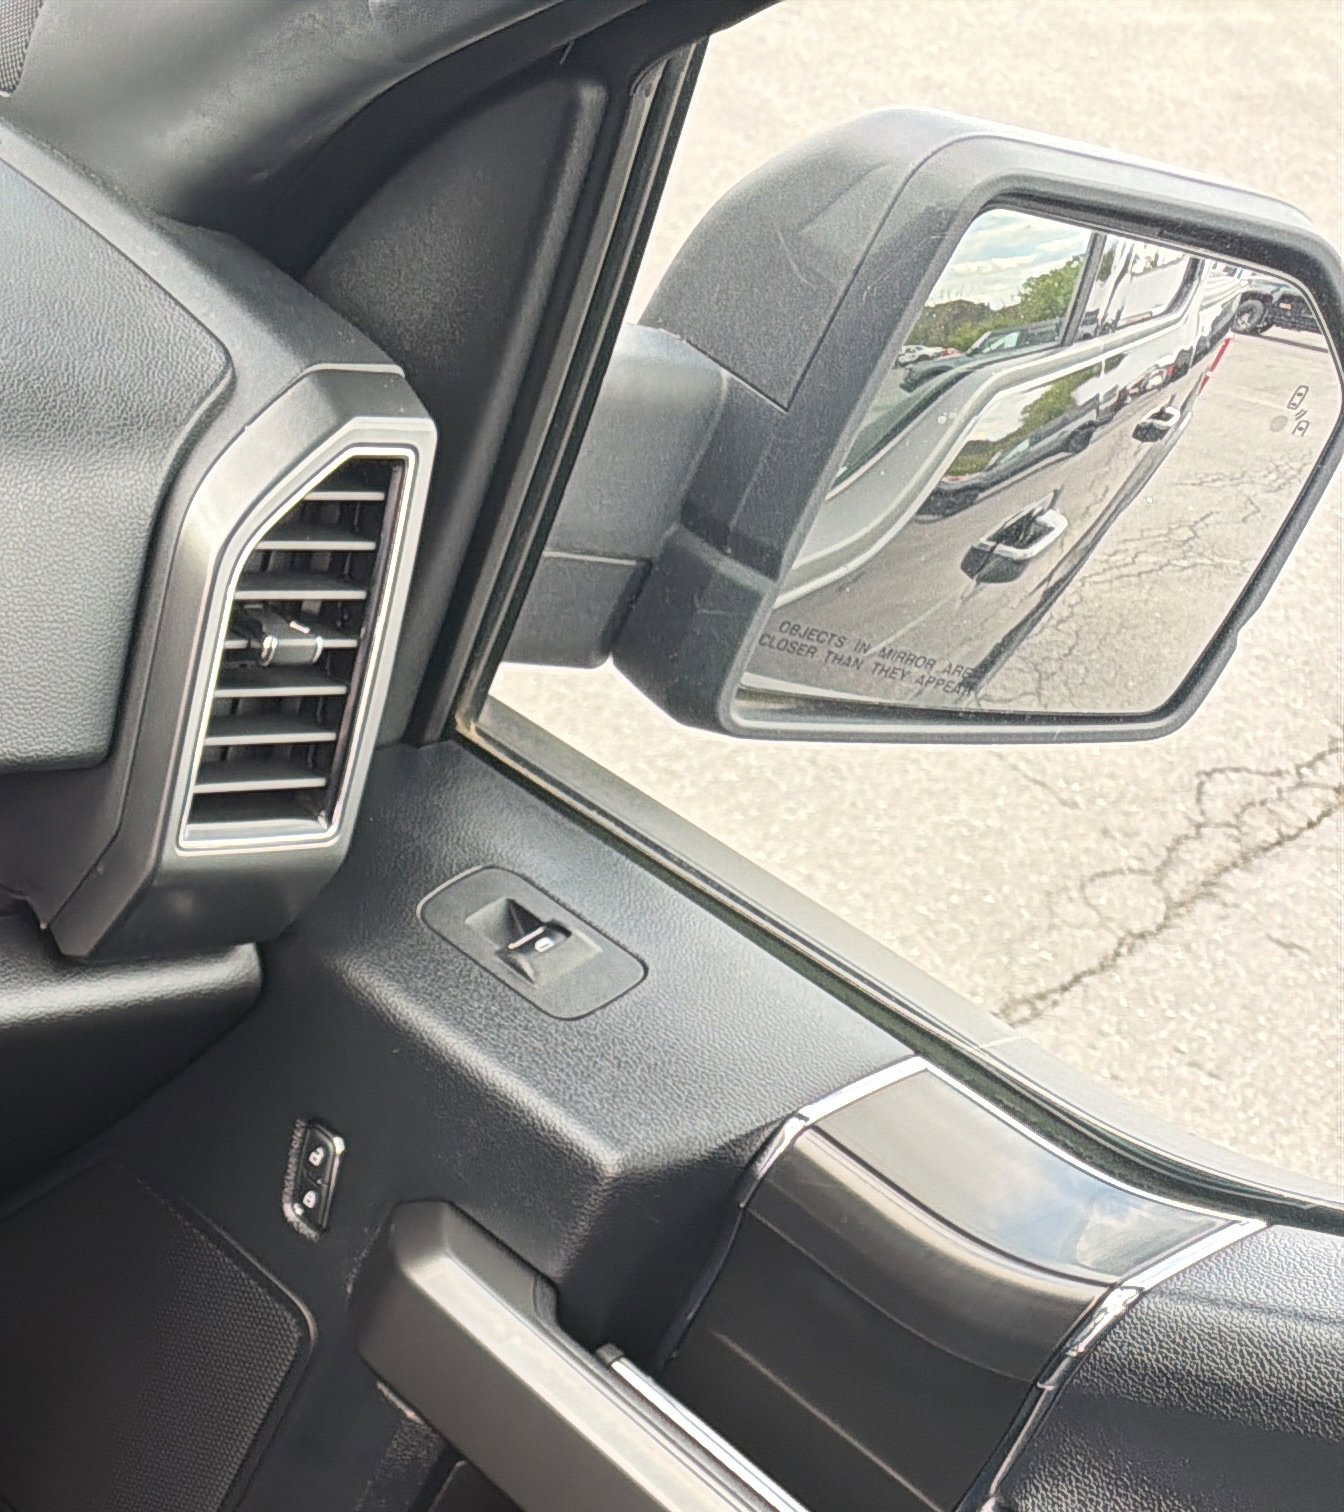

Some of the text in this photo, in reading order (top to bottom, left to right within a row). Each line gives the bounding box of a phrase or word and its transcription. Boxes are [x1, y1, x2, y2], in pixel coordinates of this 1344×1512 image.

[758, 633, 817, 659] CLOSER
[823, 650, 864, 671] THAN
[872, 662, 912, 681] THEY
[778, 620, 975, 680] OBJECTS IN MIRROR ARE
